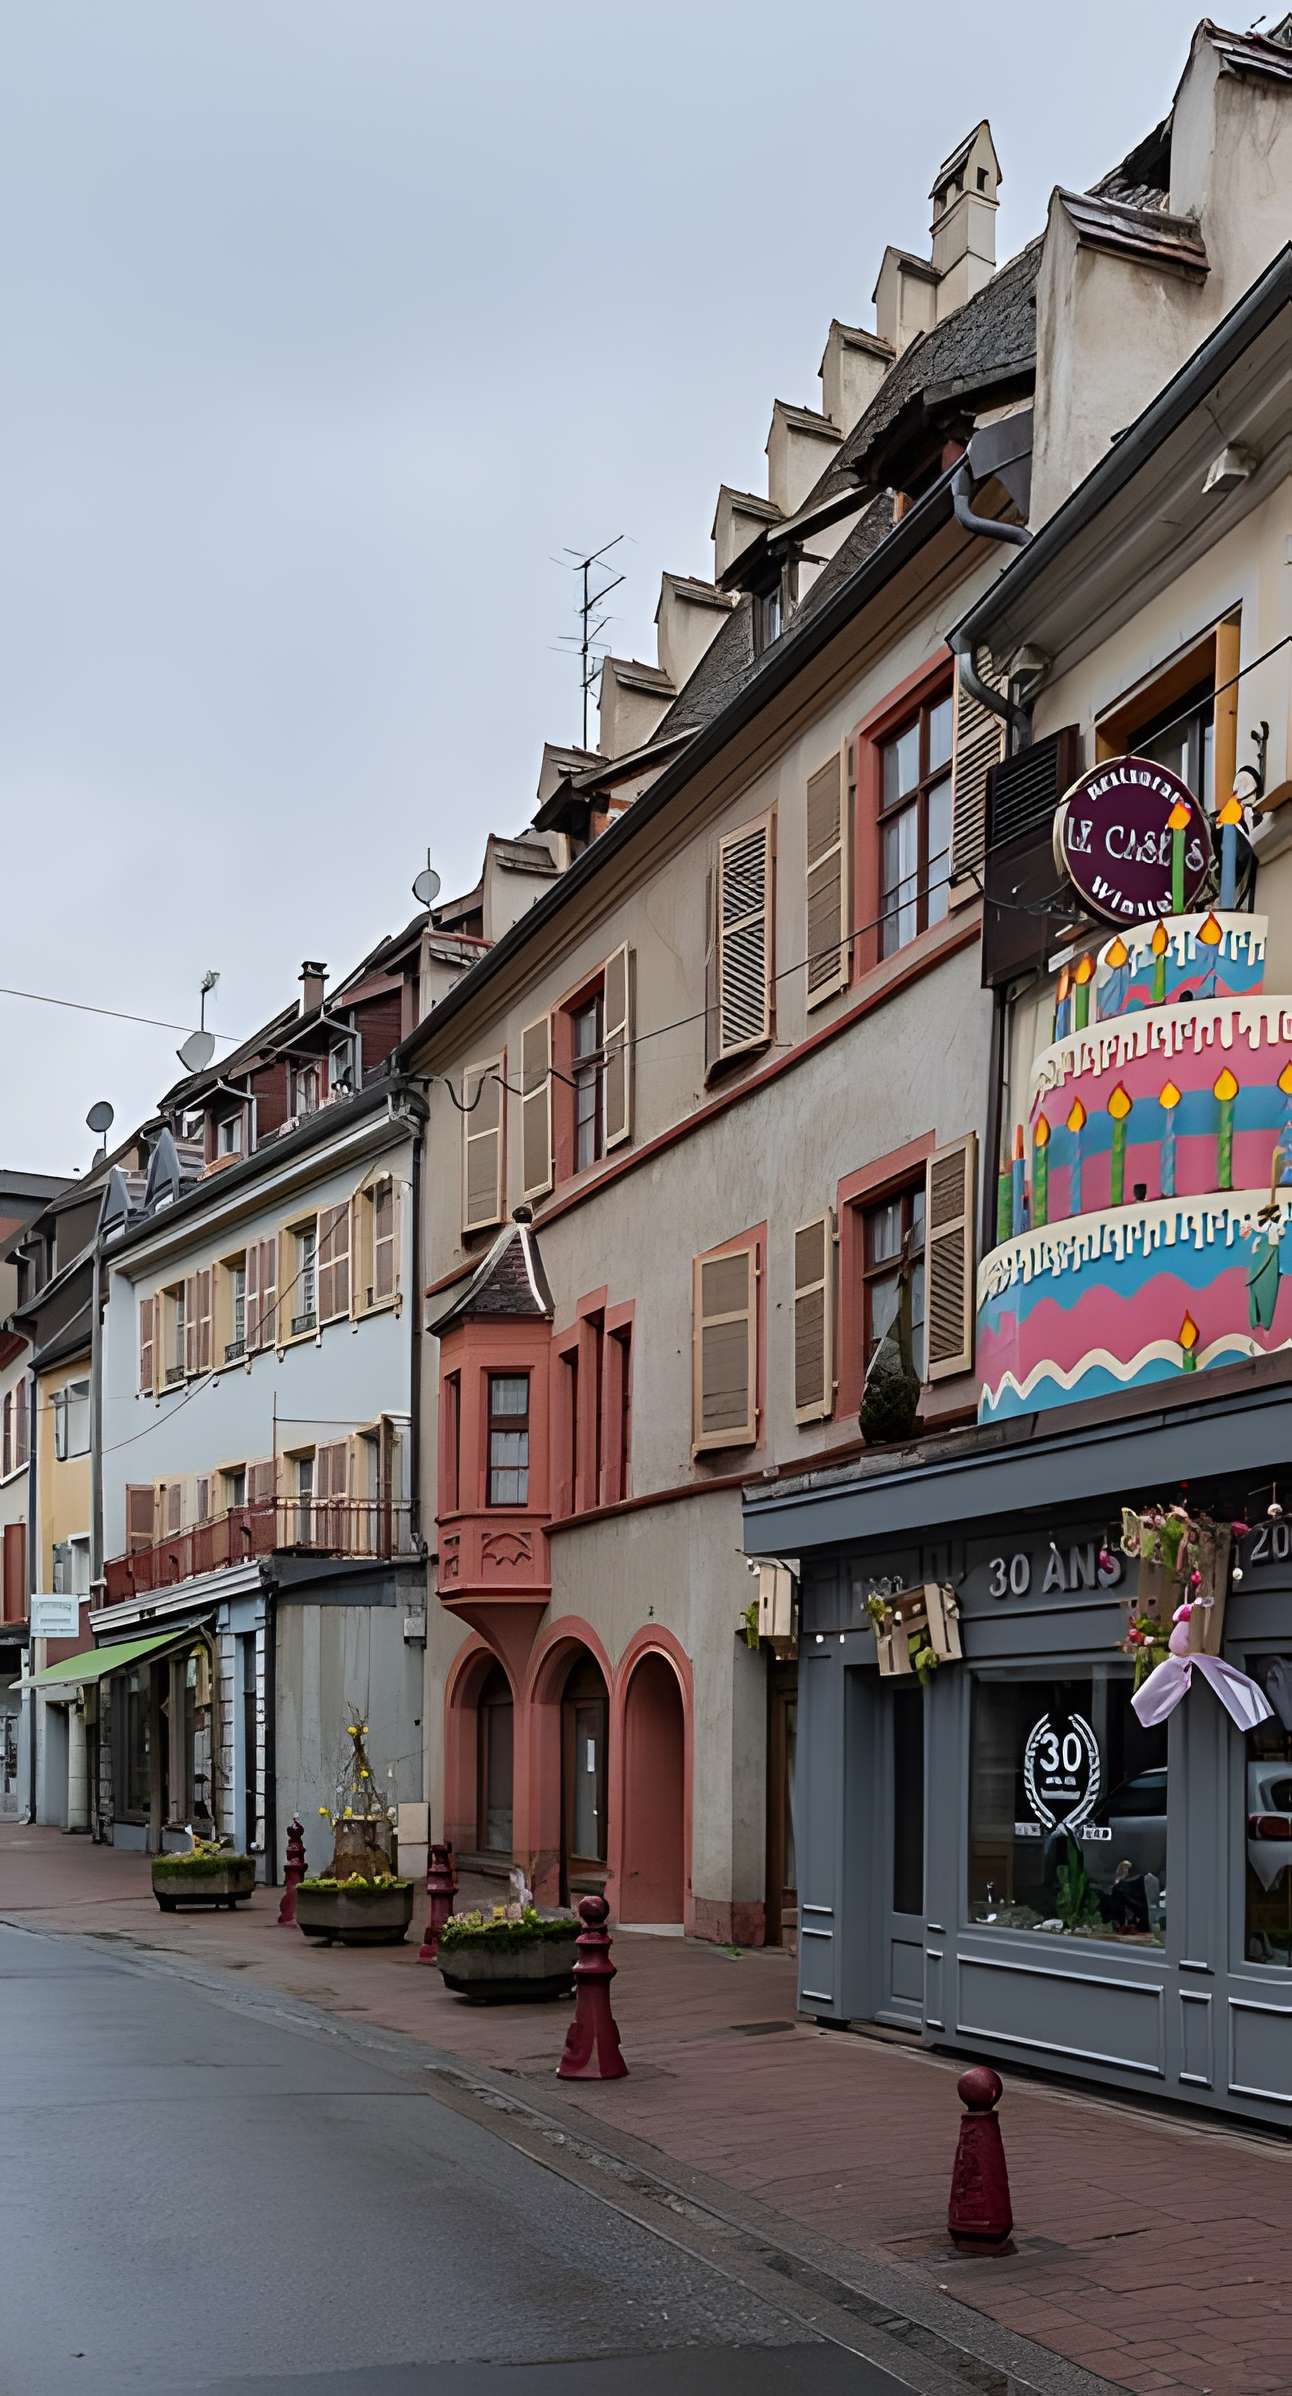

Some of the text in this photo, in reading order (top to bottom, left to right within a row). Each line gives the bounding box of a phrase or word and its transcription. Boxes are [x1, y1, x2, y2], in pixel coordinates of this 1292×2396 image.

[988, 1543, 1121, 1598] 30 ANS
[1039, 1731, 1082, 1772] 30
